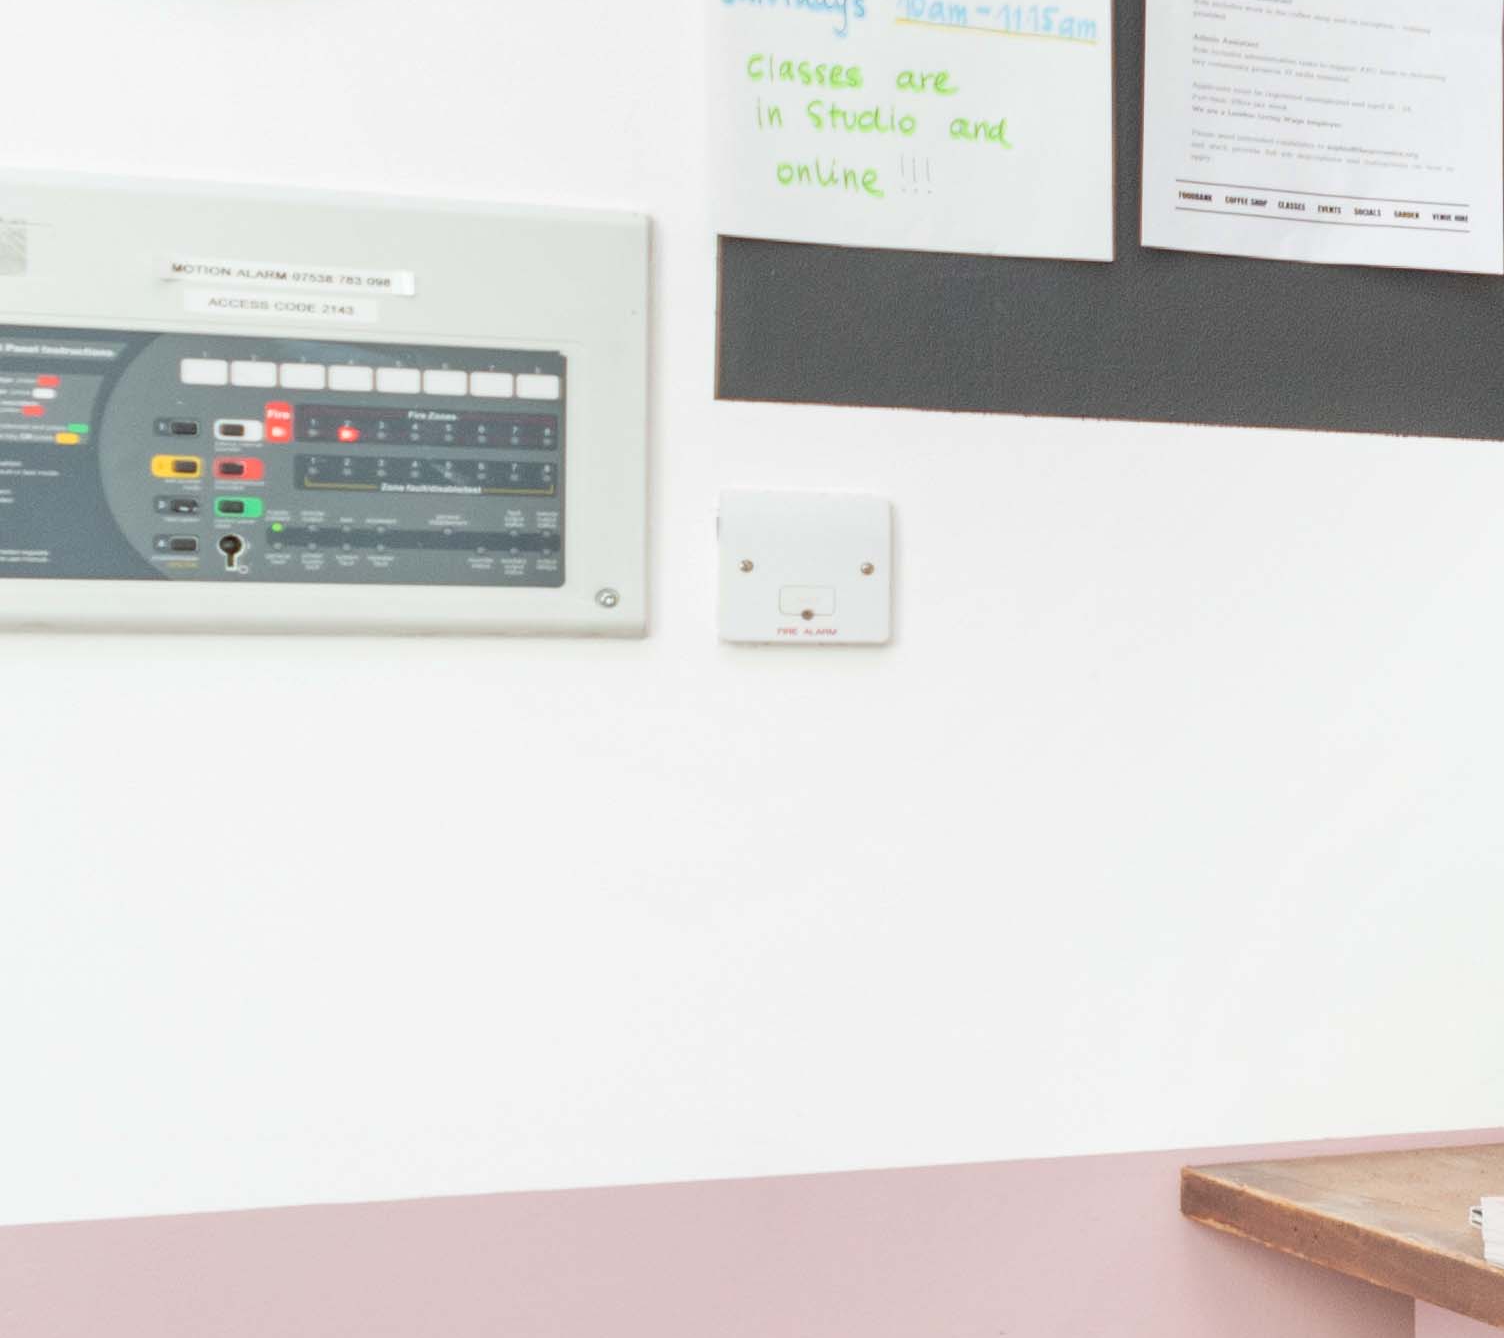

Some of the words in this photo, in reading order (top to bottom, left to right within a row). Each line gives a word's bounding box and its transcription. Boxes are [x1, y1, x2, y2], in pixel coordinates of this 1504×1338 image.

[896, 67, 959, 96] are
[755, 97, 784, 131] in
[948, 116, 1014, 151] and
[775, 157, 887, 200] online
[1278, 200, 1306, 211] CLASSES
[1317, 204, 1342, 215] EVENTS
[171, 261, 232, 277] MOTION
[236, 267, 288, 281] ALARM
[208, 296, 270, 312] ACCESS
[274, 301, 316, 314] CODE
